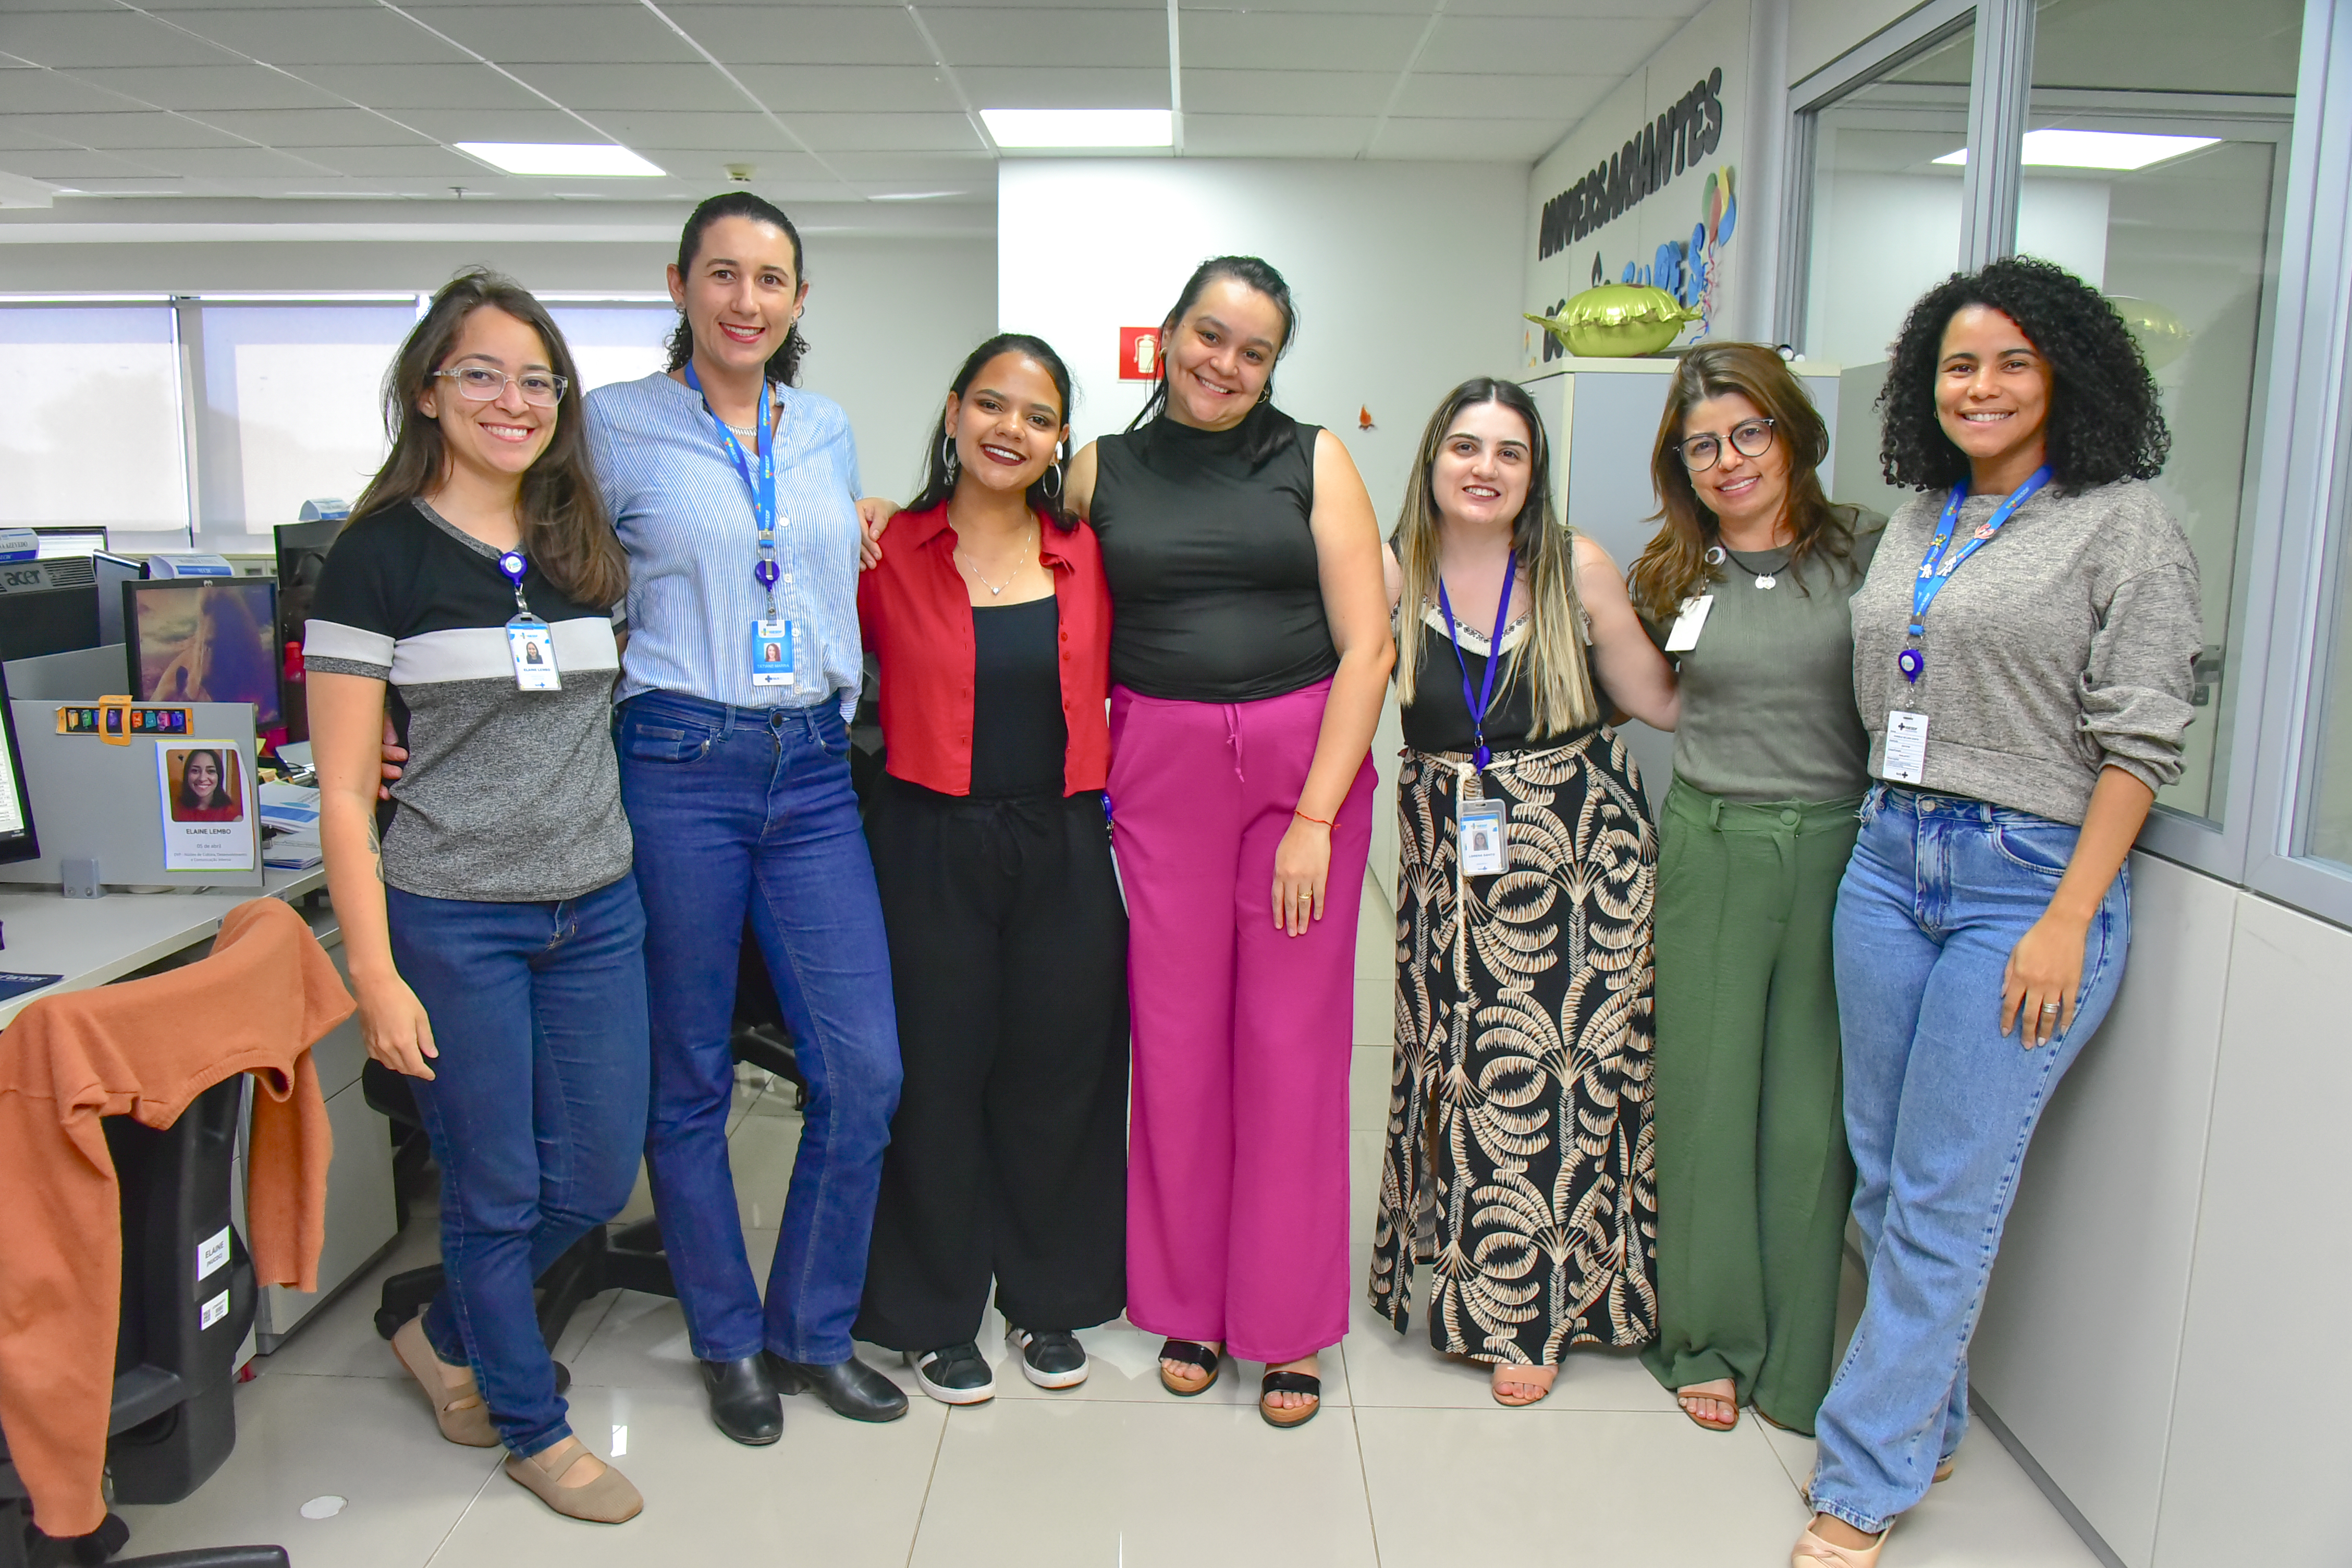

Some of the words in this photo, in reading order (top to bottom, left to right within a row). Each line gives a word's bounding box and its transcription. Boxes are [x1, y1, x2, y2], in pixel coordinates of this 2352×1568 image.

[1538, 67, 1722, 261] ANIVERSARIANTES
[4, 570, 41, 586] acer
[205, 1241, 224, 1259] ELAINE
